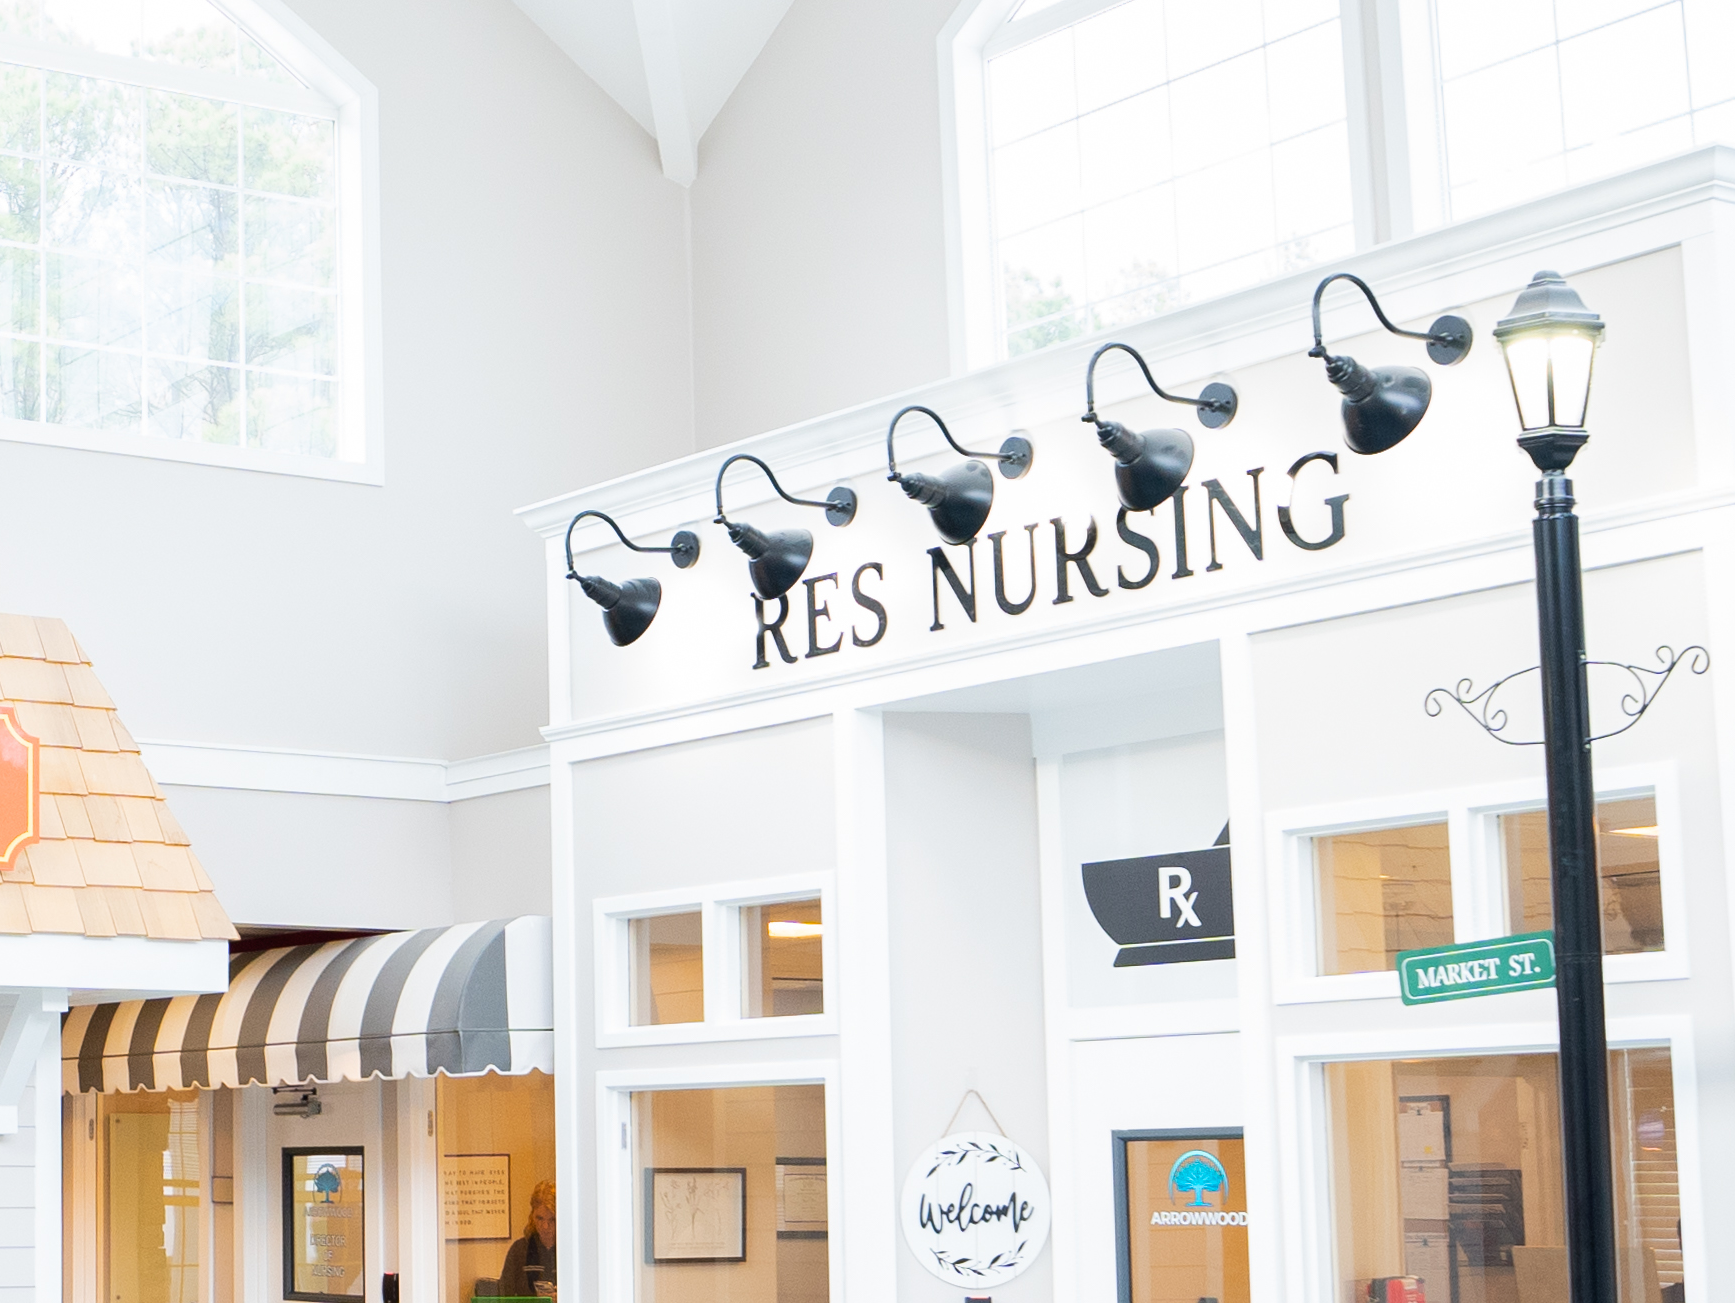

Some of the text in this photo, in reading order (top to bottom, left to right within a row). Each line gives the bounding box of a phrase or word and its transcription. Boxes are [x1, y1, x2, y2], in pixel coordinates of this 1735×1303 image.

[749, 451, 1350, 670] RES NURSING
[1415, 952, 1542, 989] MARKET ST.
[919, 1182, 1035, 1234] Welcome
[1150, 1211, 1248, 1226] ARROWWOOD
